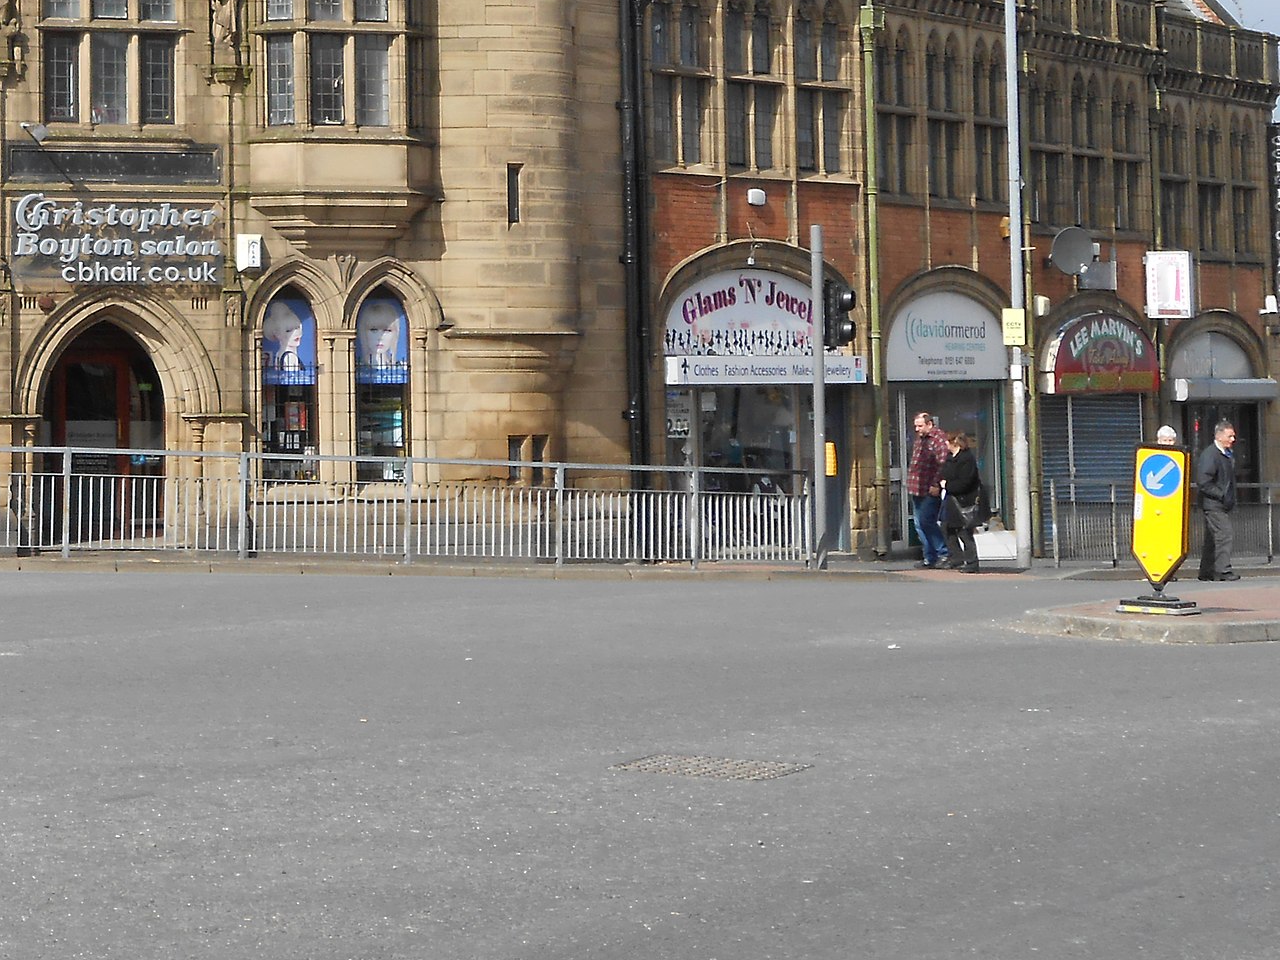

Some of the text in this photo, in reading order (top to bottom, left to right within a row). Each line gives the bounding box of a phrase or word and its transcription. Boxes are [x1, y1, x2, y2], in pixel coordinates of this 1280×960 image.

[15, 193, 218, 233] Christopher
[14, 233, 220, 262] Boyton salon
[61, 261, 217, 283] cbhair.co.uk
[682, 286, 736, 324] Glams
[765, 281, 814, 326] Jewel
[917, 319, 986, 339] davidormerod
[1070, 318, 1143, 357] LEE MARVIN'S
[693, 364, 719, 376] Clothes
[724, 364, 749, 376] Fashion
[750, 364, 787, 376] Accessories
